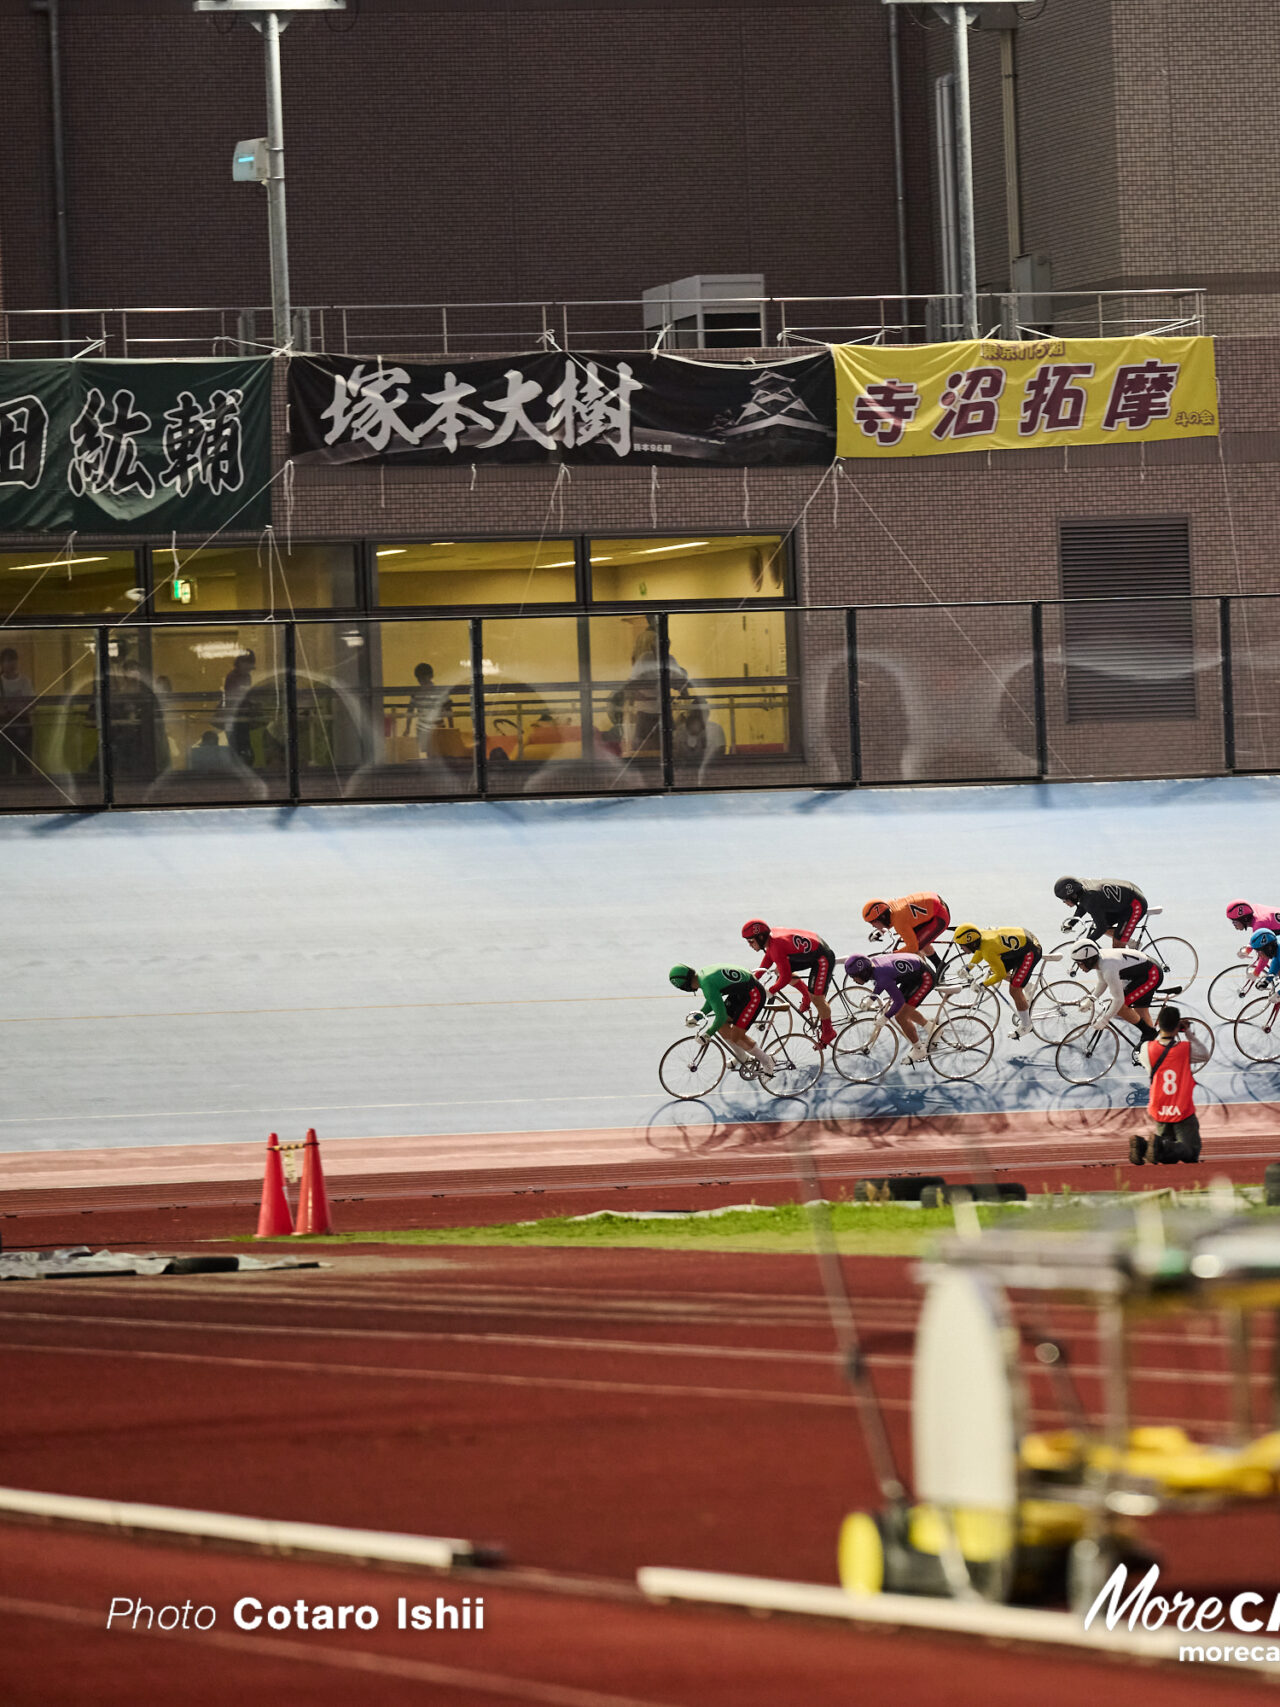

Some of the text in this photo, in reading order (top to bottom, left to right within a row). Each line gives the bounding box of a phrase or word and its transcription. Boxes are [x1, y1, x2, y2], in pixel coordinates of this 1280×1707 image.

[320, 360, 643, 457] 塚本大樹
[854, 359, 1180, 446] 寺沼拓摩
[1175, 409, 1215, 427] 斗の会
[1102, 884, 1122, 903] 2
[873, 905, 881, 915] 7
[910, 903, 928, 919] 7
[1238, 906, 1244, 916] 8
[792, 934, 812, 953] 3
[965, 933, 973, 943] 5
[1001, 935, 1021, 950] 5
[1260, 935, 1267, 945] 4
[893, 959, 914, 974] 9
[722, 968, 742, 983] 6
[1162, 1069, 1178, 1095] 8
[1157, 1105, 1182, 1116] JKA
